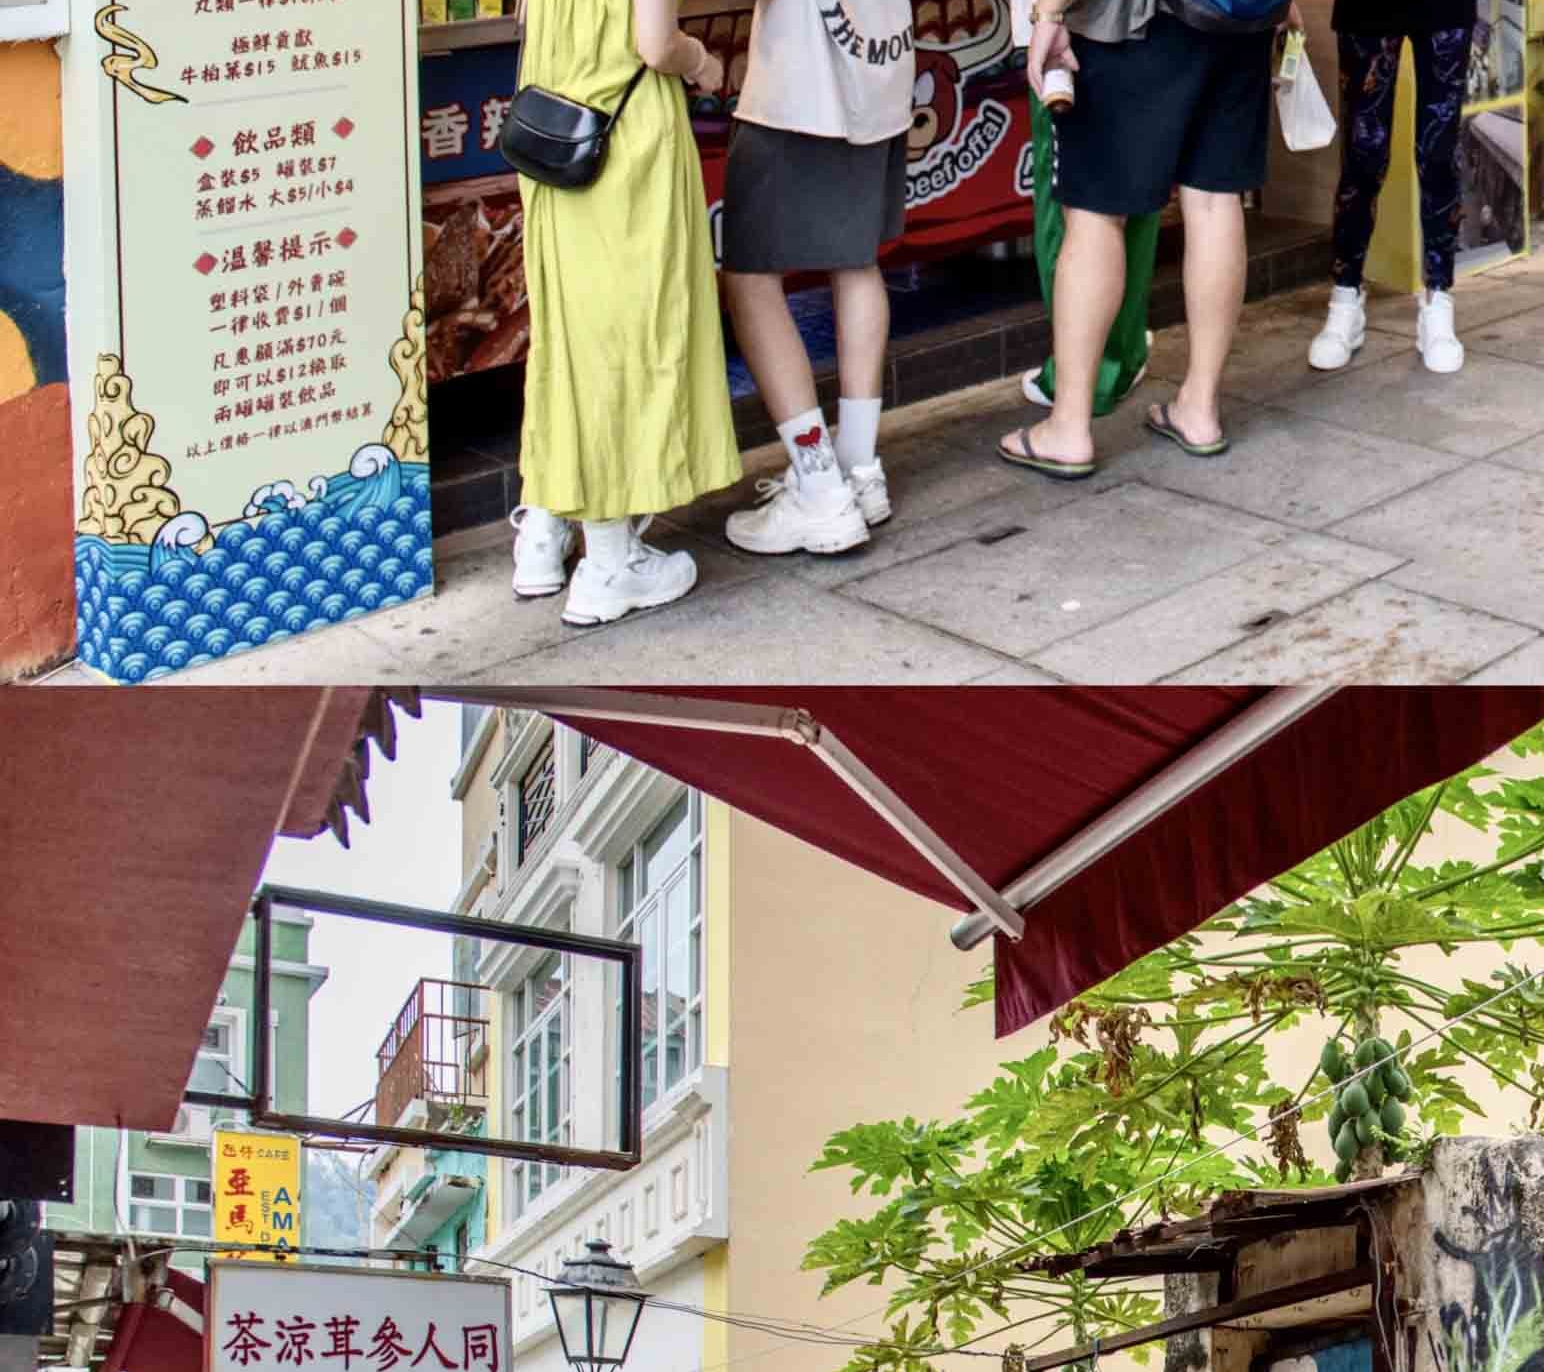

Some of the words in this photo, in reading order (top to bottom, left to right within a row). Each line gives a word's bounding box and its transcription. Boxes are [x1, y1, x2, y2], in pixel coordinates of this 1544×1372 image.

[231, 119, 317, 157] 飲品類
[956, 103, 1010, 173] offal
[224, 1168, 255, 1258] 亞馬
